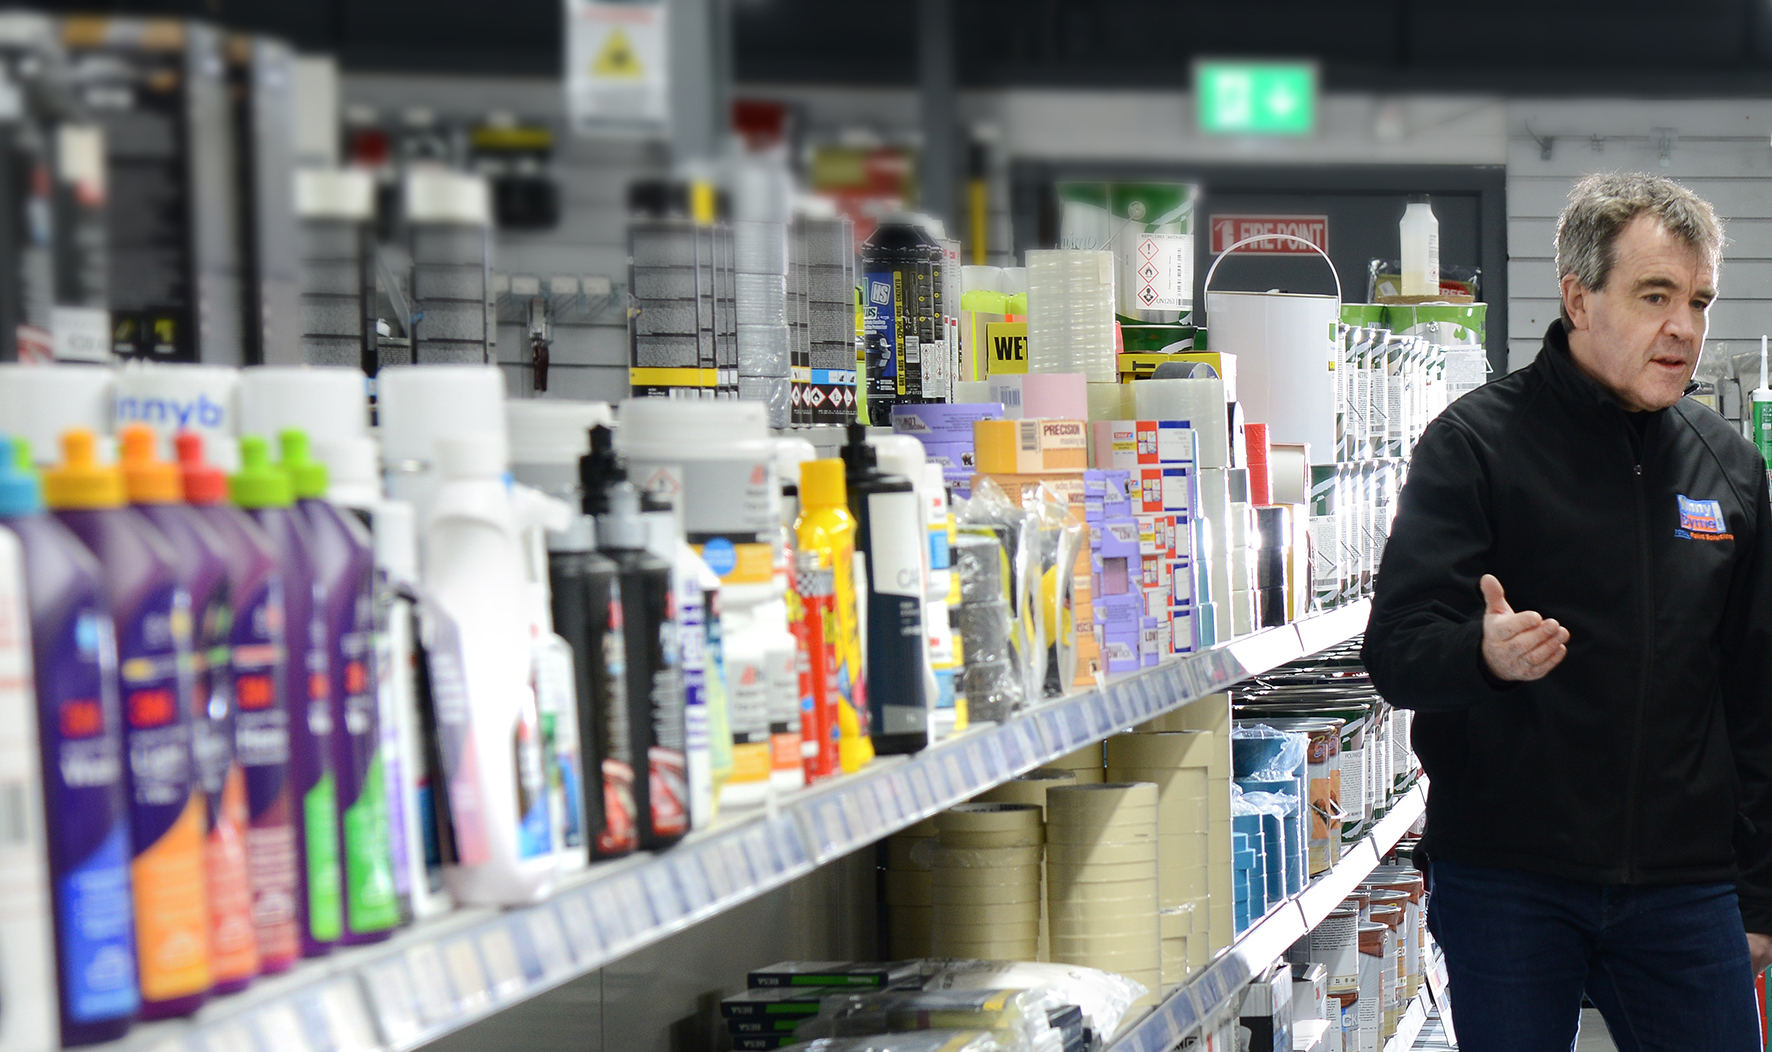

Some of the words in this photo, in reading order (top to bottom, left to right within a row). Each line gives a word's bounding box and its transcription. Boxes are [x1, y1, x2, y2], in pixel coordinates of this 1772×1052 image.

[1240, 223, 1273, 250] FIRE
[1276, 222, 1324, 250] POINT
[1043, 425, 1080, 436] PRECISION
